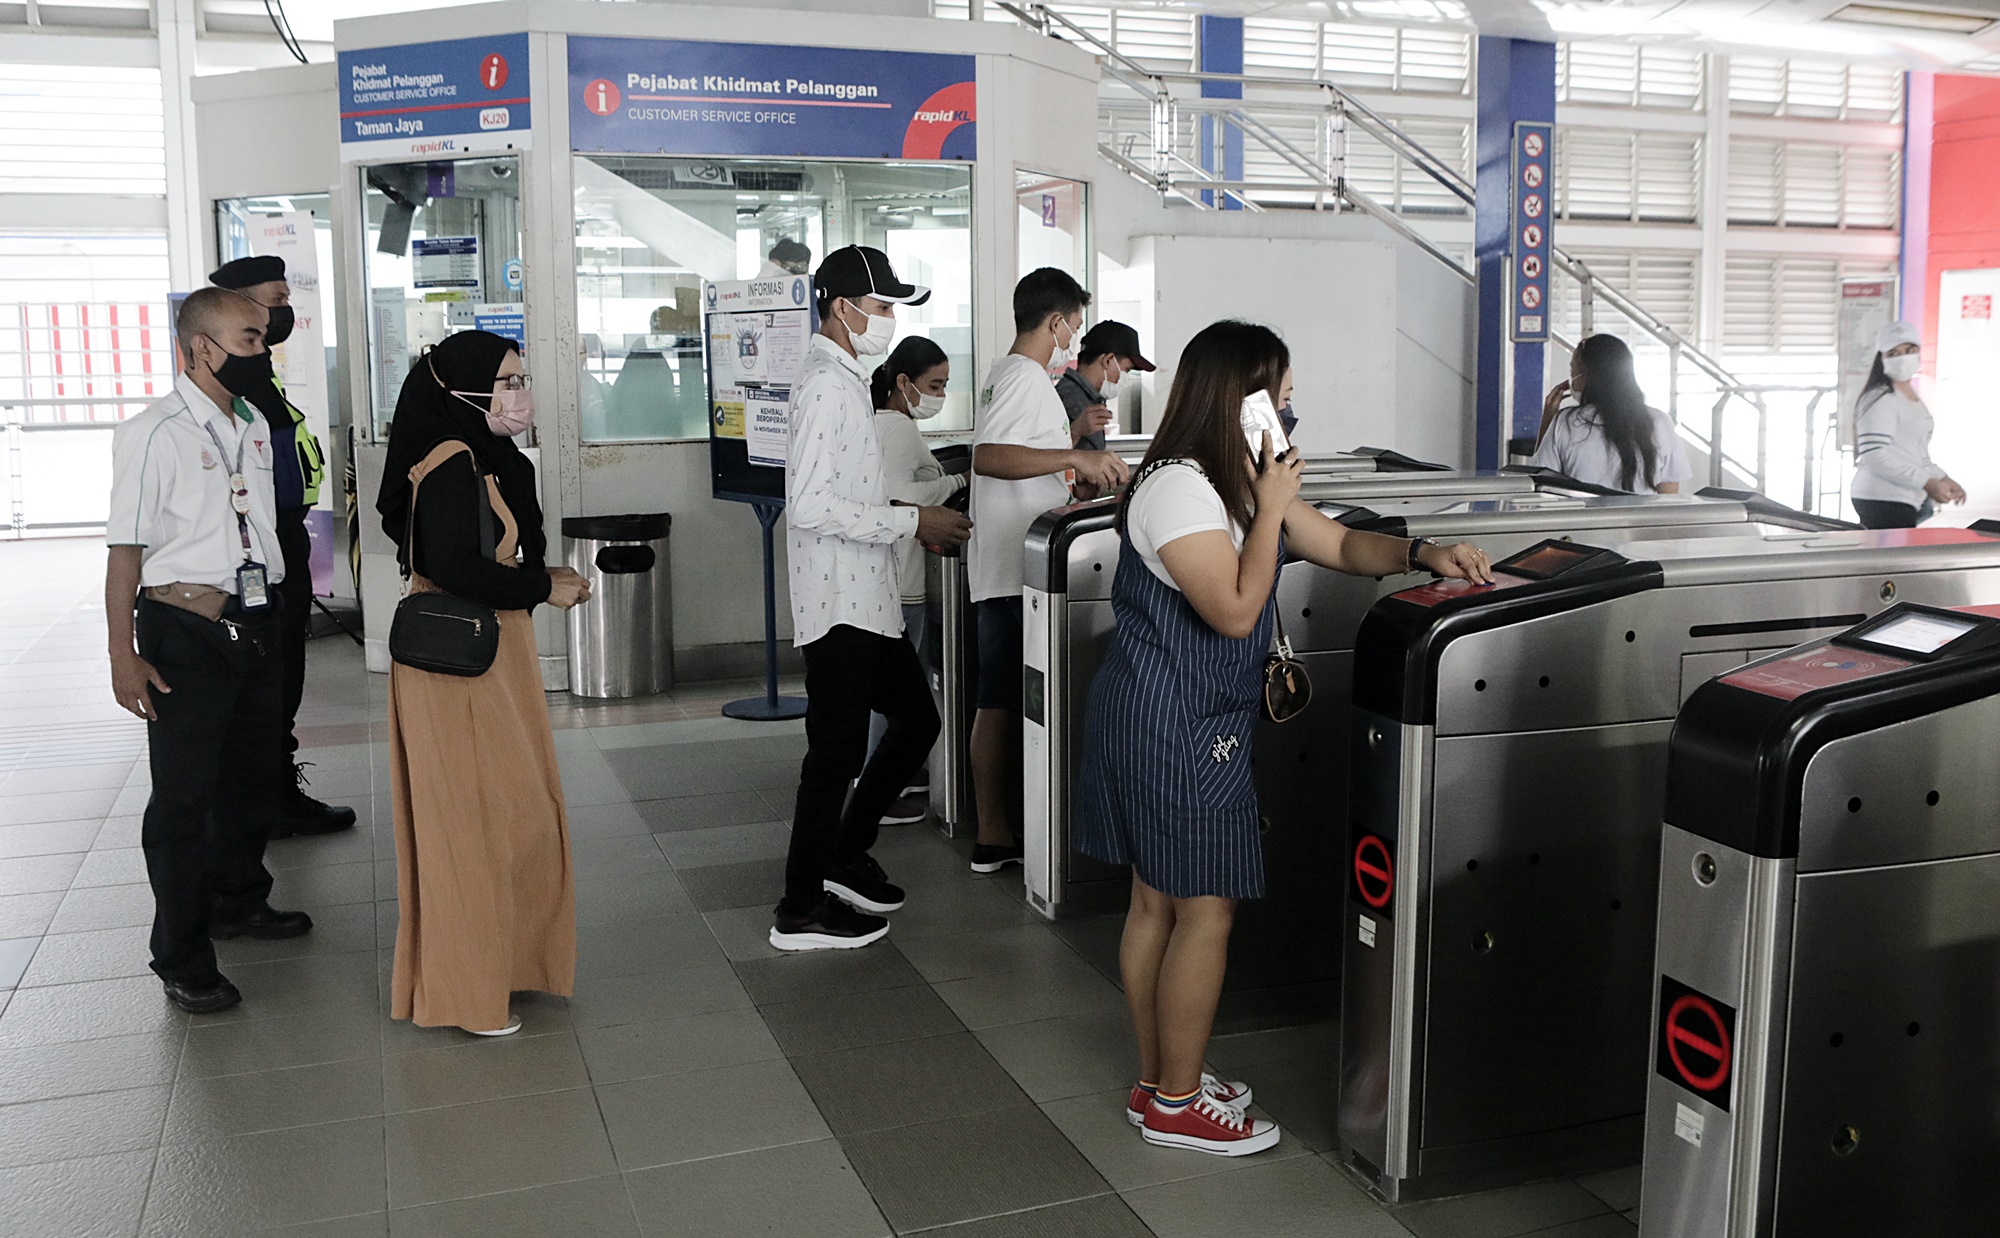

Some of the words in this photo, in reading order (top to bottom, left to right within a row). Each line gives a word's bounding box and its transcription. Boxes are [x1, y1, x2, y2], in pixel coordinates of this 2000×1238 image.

[352, 64, 387, 78] Pejabat
[352, 76, 392, 91] Khidmat
[393, 74, 443, 88] Pelanggan
[627, 73, 698, 92] Pejabat
[703, 76, 781, 93] Khidmat
[786, 79, 878, 99] Pelanggan
[354, 90, 395, 103] CUSTOMER
[395, 87, 428, 99] SERVICE
[429, 85, 457, 97] OFFICE
[482, 112, 507, 125] KJ20
[628, 108, 698, 121] CUSTOMER
[701, 110, 751, 122] SERVICE
[754, 111, 796, 124] OFFICE
[913, 110, 971, 124] rapidKL
[355, 121, 393, 136] Taman
[395, 119, 423, 135] Jaya
[411, 140, 456, 154] rapidKL
[1045, 197, 1054, 224] 2
[748, 281, 784, 297] INFORMASI
[748, 298, 773, 306] INFORMATION
[760, 407, 783, 416] KEMBALI
[759, 426, 781, 434] NOVEMBER
[1212, 735, 1226, 762] girl
[1220, 735, 1239, 761] gang
